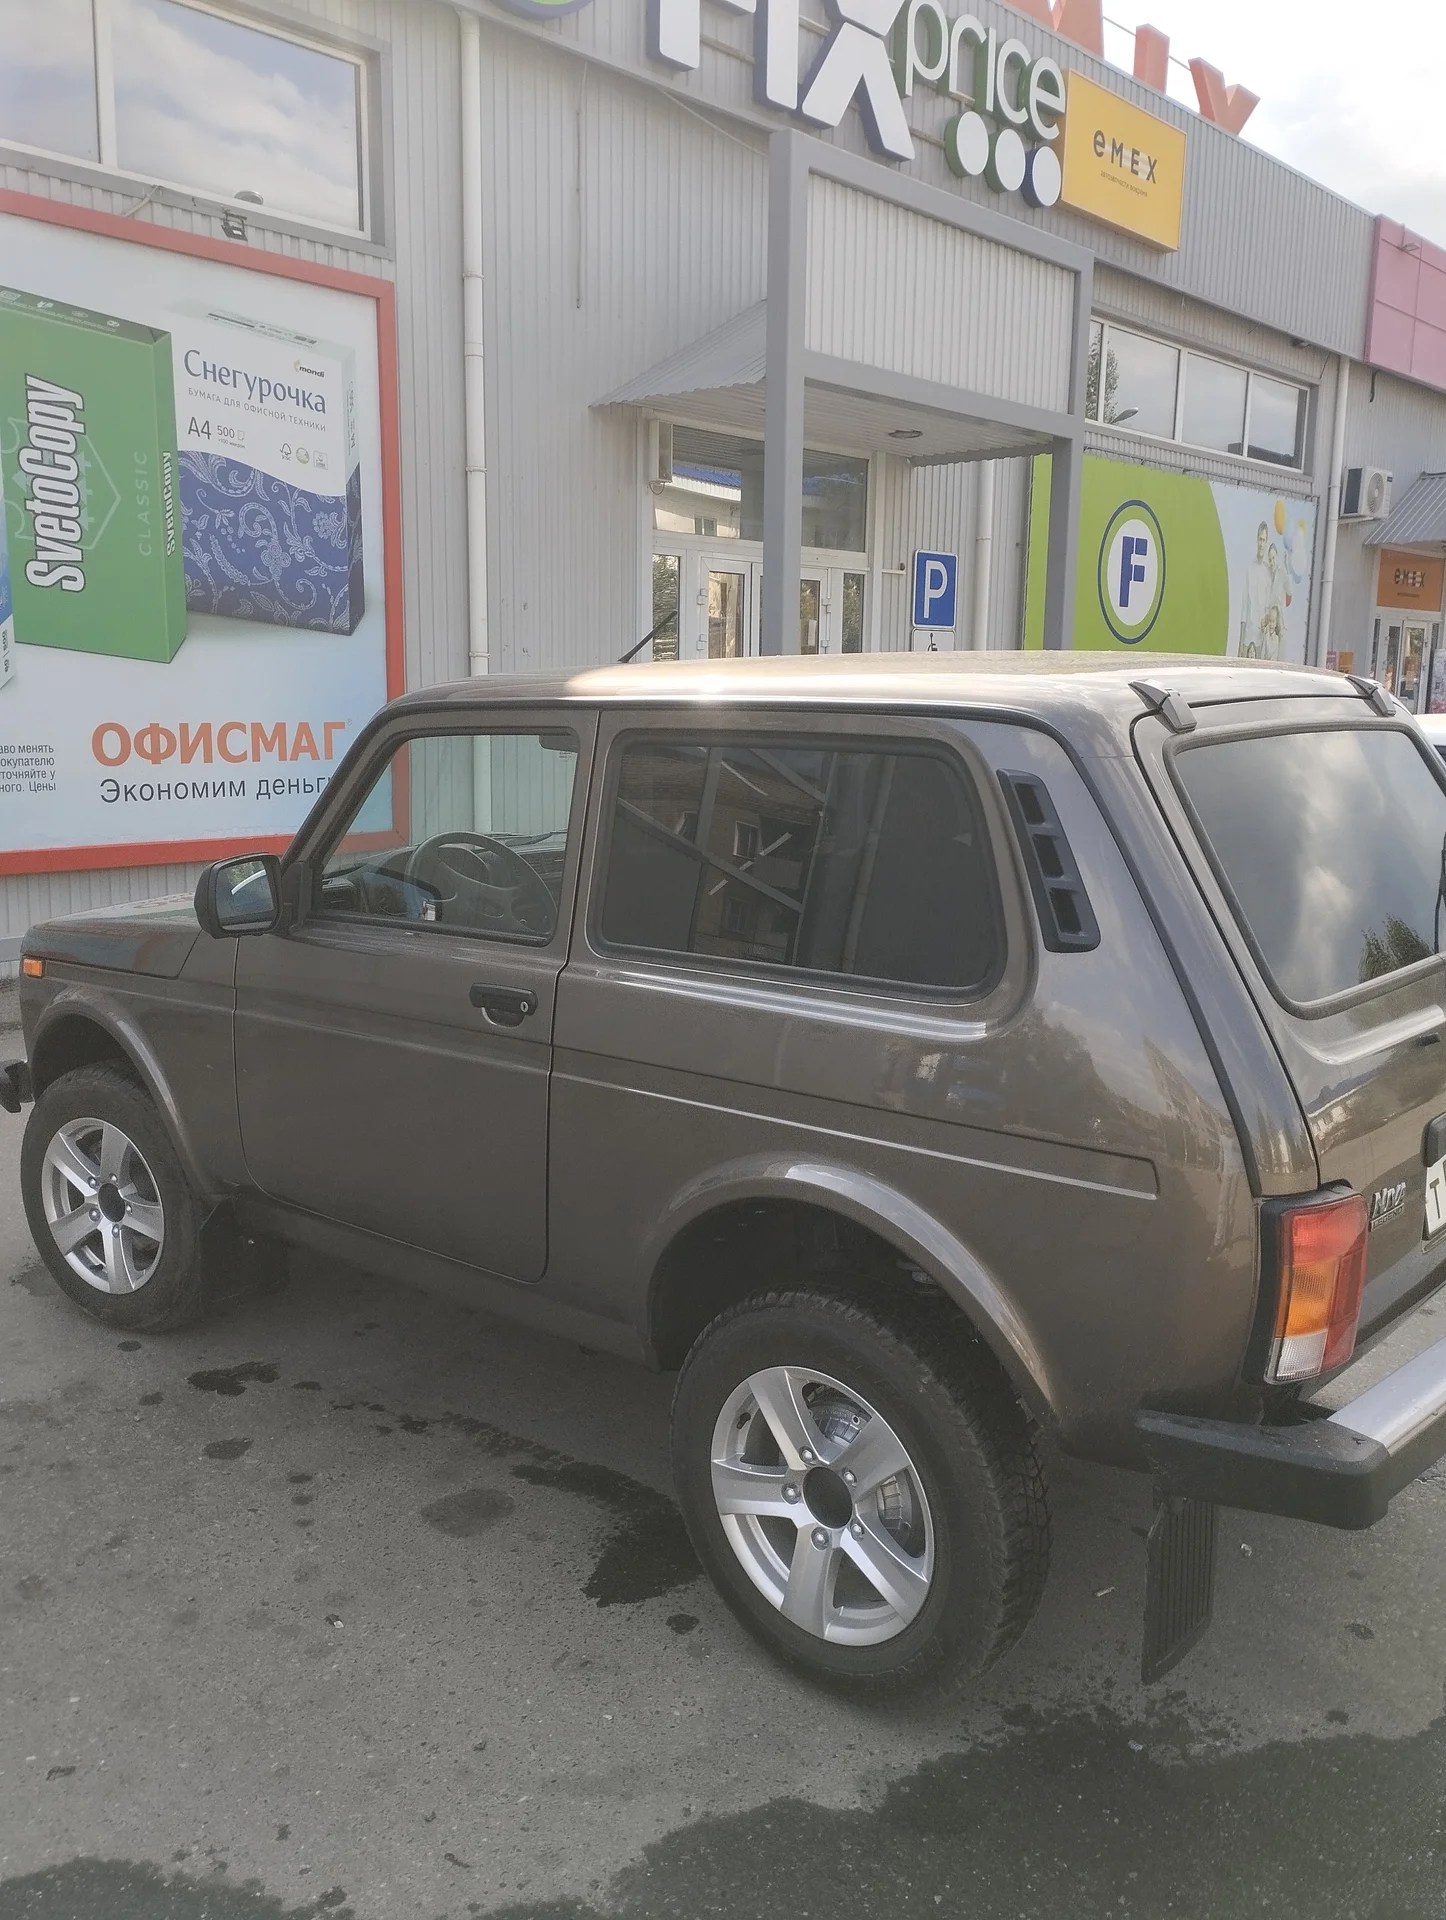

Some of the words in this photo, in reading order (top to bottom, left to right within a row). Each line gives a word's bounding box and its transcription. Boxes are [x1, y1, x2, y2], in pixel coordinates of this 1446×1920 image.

[905, 0, 1066, 140] price
[184, 350, 326, 414] Снегурочка
[299, 366, 325, 378] mondi
[188, 387, 221, 403] БУМАГА
[223, 397, 241, 409] ДЛЯ
[244, 402, 286, 421] ОФИСНОЙ
[289, 415, 326, 432] ТЕХНИКИ
[188, 416, 212, 440] A4
[217, 424, 235, 439] 500
[18, 373, 86, 593] SvetoCopy
[134, 451, 152, 556] CLASSIC
[162, 450, 176, 557] SvetoCopy
[923, 560, 948, 619] P
[18, 744, 54, 754] менять
[91, 721, 346, 767] ОФИСМАГ
[29, 781, 57, 793] Цены
[50, 770, 56, 781] у
[100, 778, 247, 803] Экономим
[256, 776, 333, 800] деньг
